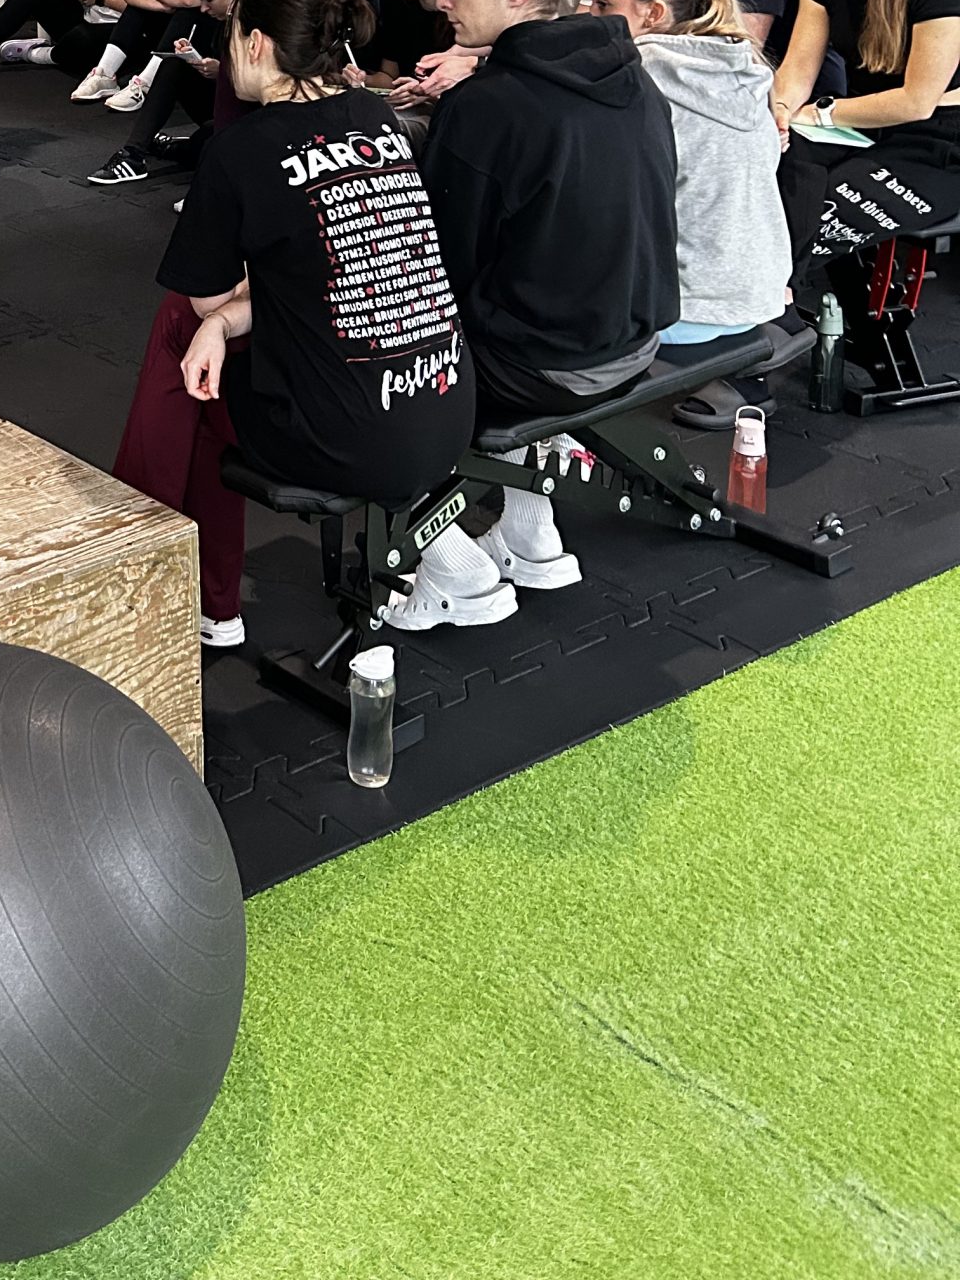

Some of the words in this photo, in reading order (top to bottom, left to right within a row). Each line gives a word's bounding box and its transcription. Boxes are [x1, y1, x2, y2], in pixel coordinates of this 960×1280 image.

[320, 179, 373, 205] GOGOL
[326, 201, 362, 221] DŻEM
[365, 192, 409, 211] PIDŻAMA
[835, 183, 862, 203] bad
[860, 200, 900, 230] things
[326, 215, 377, 237] RIVERSIDE
[382, 206, 418, 222] DEZERTER
[333, 233, 364, 249] DARIA
[401, 233, 423, 246] TWIST
[336, 271, 375, 288] FARBEN
[374, 264, 402, 280] LEHRE
[405, 259, 424, 271] COOL
[345, 260, 370, 274] ANIA
[369, 249, 411, 267] RUSOWICZ
[329, 287, 366, 302] ALIANS
[374, 280, 392, 293] EYE
[392, 277, 409, 289] FOR
[418, 270, 431, 283] EYE
[336, 314, 370, 329] OCEAN
[374, 304, 412, 323] BRUKLIN
[338, 299, 375, 314] BRUDNE
[375, 293, 403, 308] DZIECI
[348, 322, 397, 339] ACAPULCO
[402, 310, 441, 330] PENTHOUSE
[380, 332, 413, 349] SMOKES
[381, 331, 460, 410] festiwal
